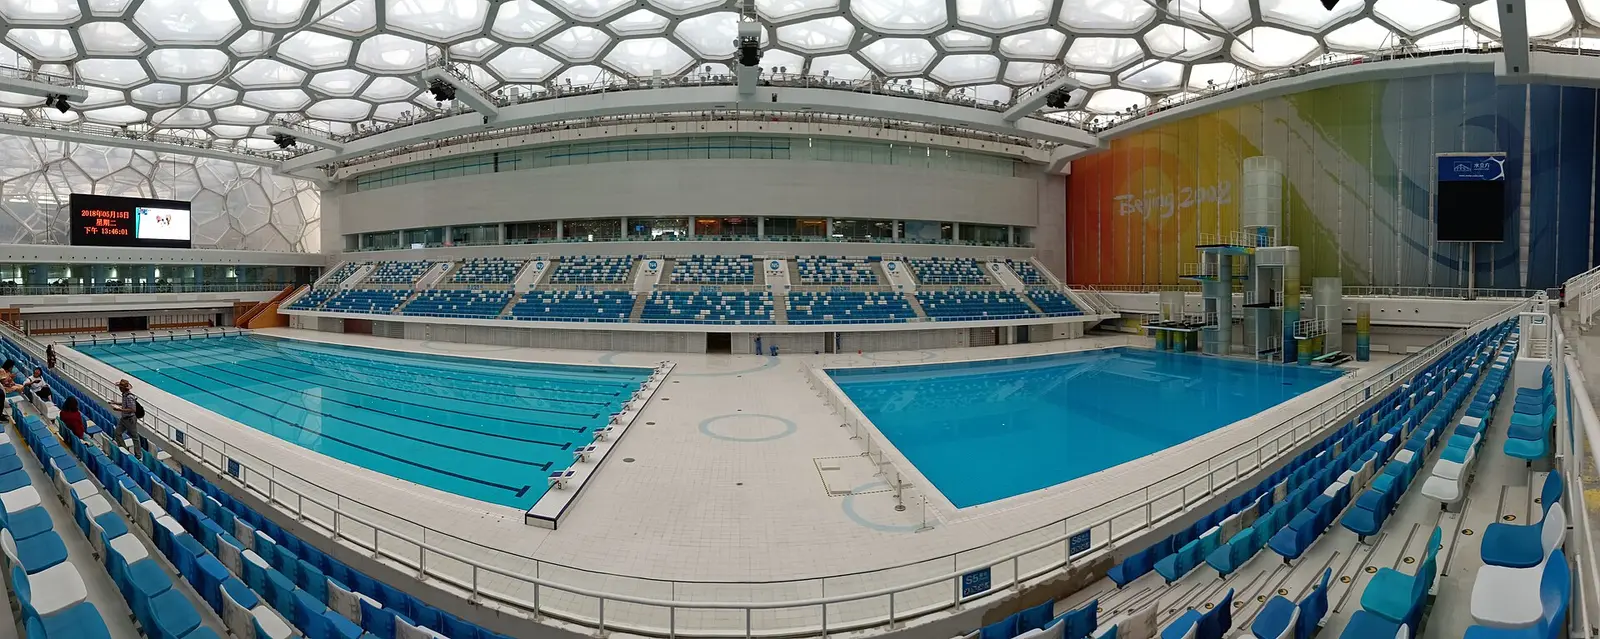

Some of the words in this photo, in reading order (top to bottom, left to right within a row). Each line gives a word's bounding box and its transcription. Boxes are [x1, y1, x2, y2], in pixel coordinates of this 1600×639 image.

[1114, 187, 1174, 219] Beijing
[81, 209, 129, 219] 2018年05月15日
[96, 218, 116, 227] 星期二
[84, 226, 98, 235] 下午
[101, 227, 128, 235] 13:46:01
[965, 573, 979, 585] S5
